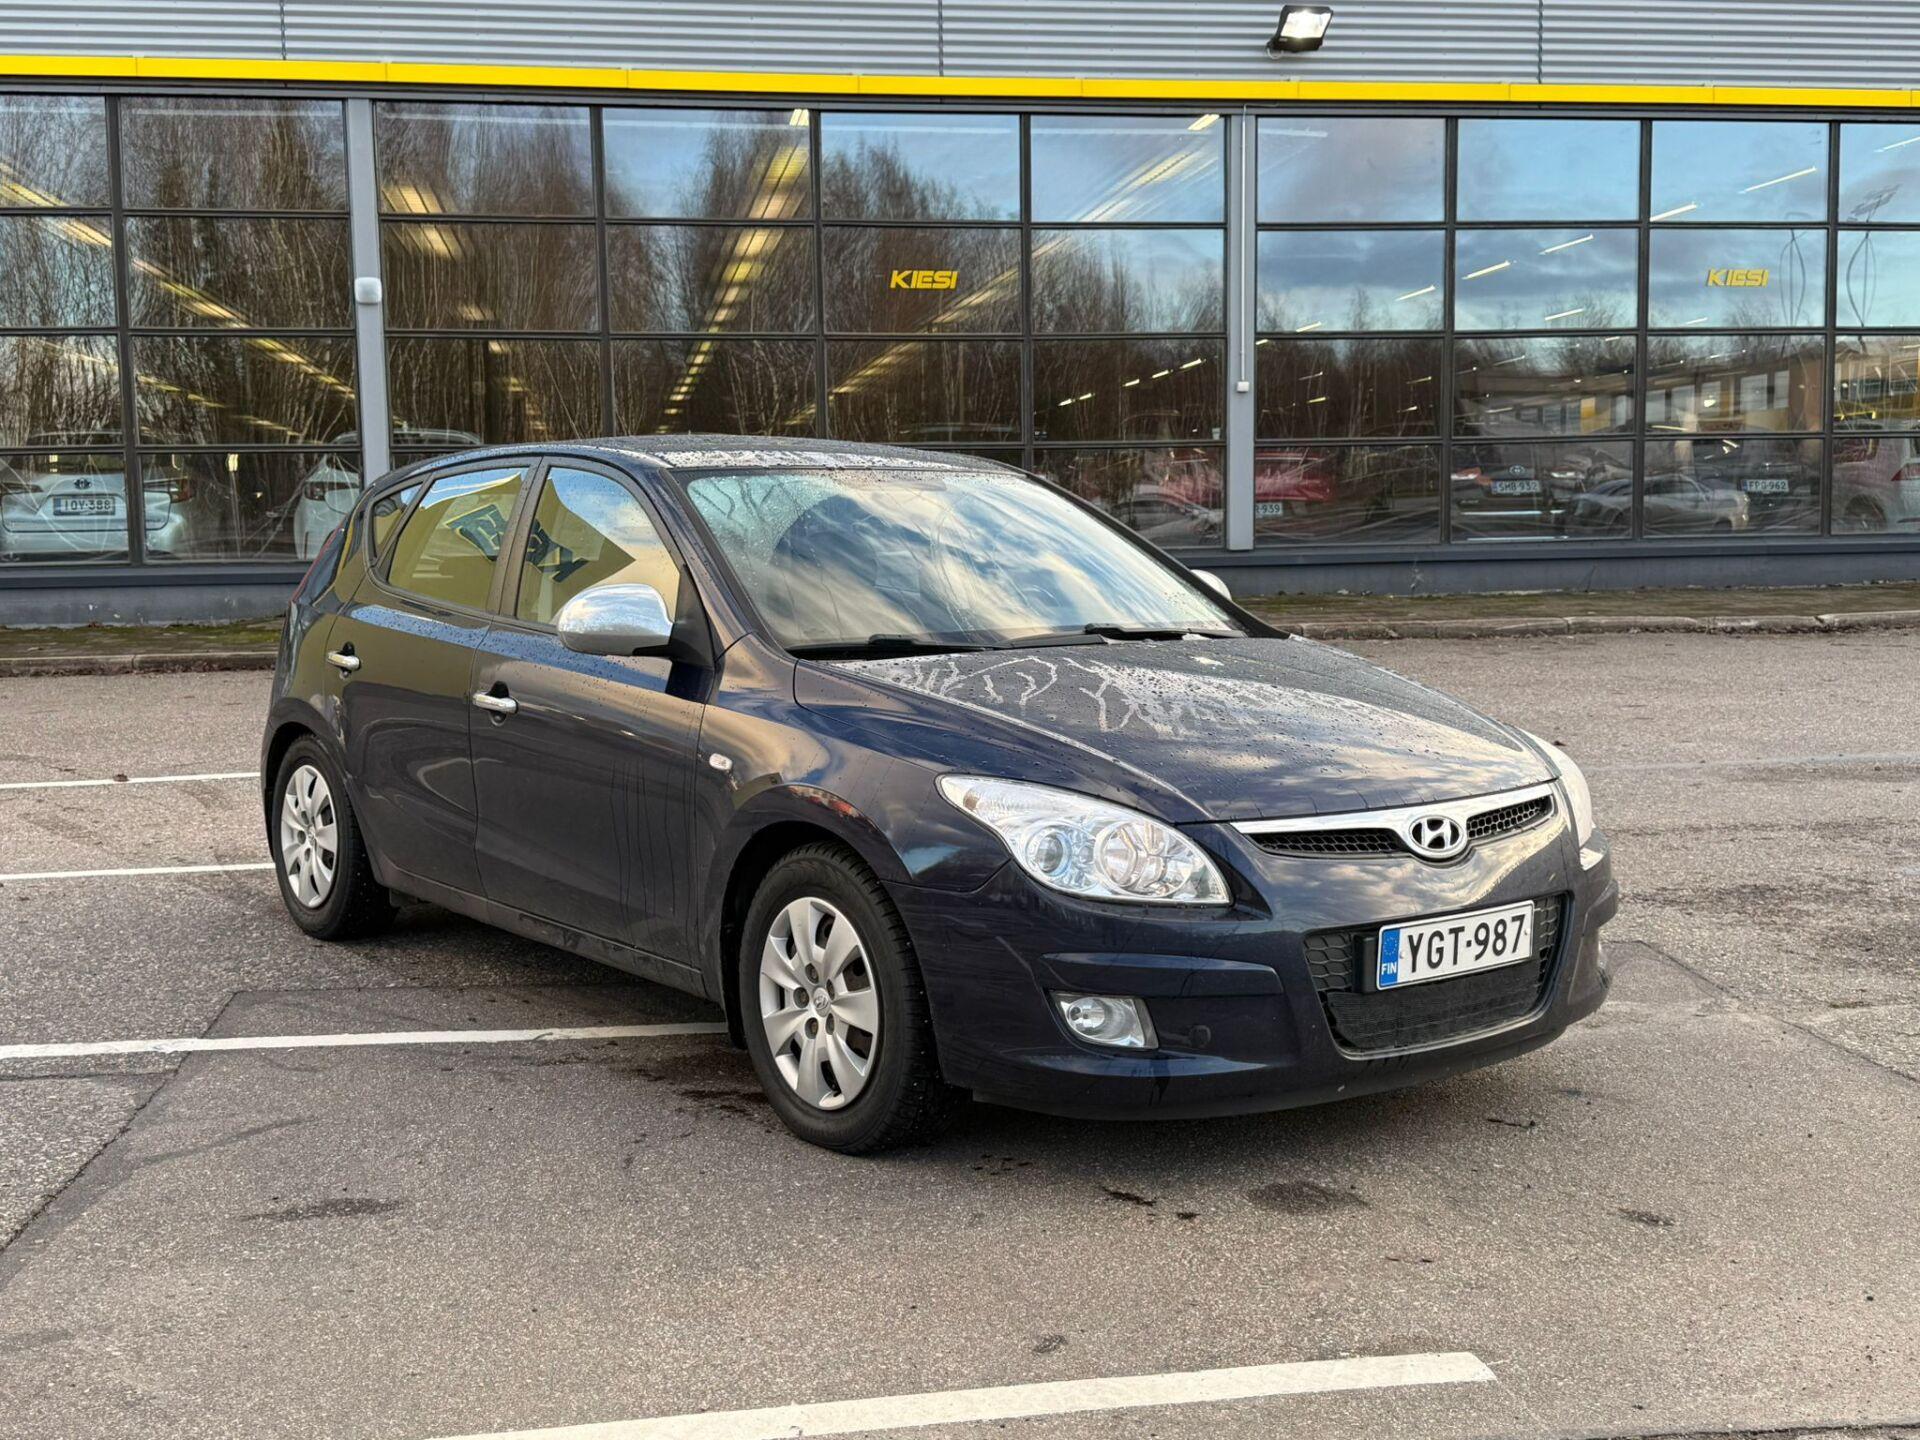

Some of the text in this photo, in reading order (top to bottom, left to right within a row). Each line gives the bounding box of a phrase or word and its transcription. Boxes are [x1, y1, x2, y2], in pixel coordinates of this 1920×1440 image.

[890, 270, 959, 289] KIESI
[1707, 269, 1769, 287] KIESI
[1381, 961, 1397, 975] FIN
